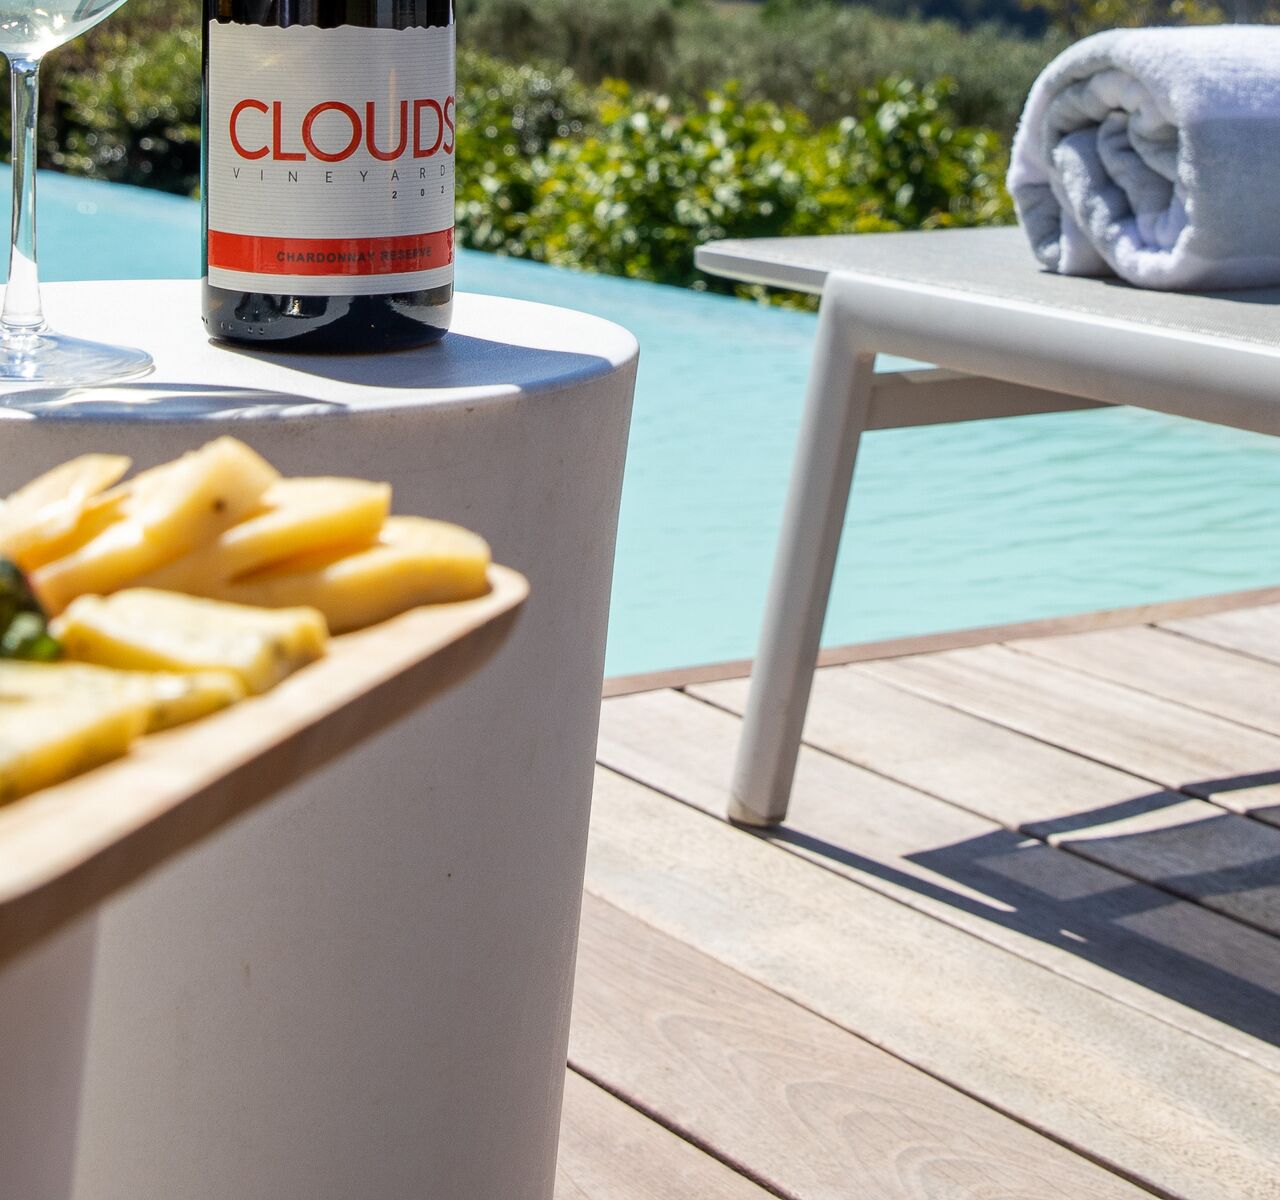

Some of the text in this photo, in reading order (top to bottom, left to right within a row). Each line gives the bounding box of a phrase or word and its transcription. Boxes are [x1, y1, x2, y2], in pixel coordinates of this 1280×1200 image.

[229, 96, 455, 162] CLOUDS
[276, 246, 432, 264] CHARDONNAY RESERVE
